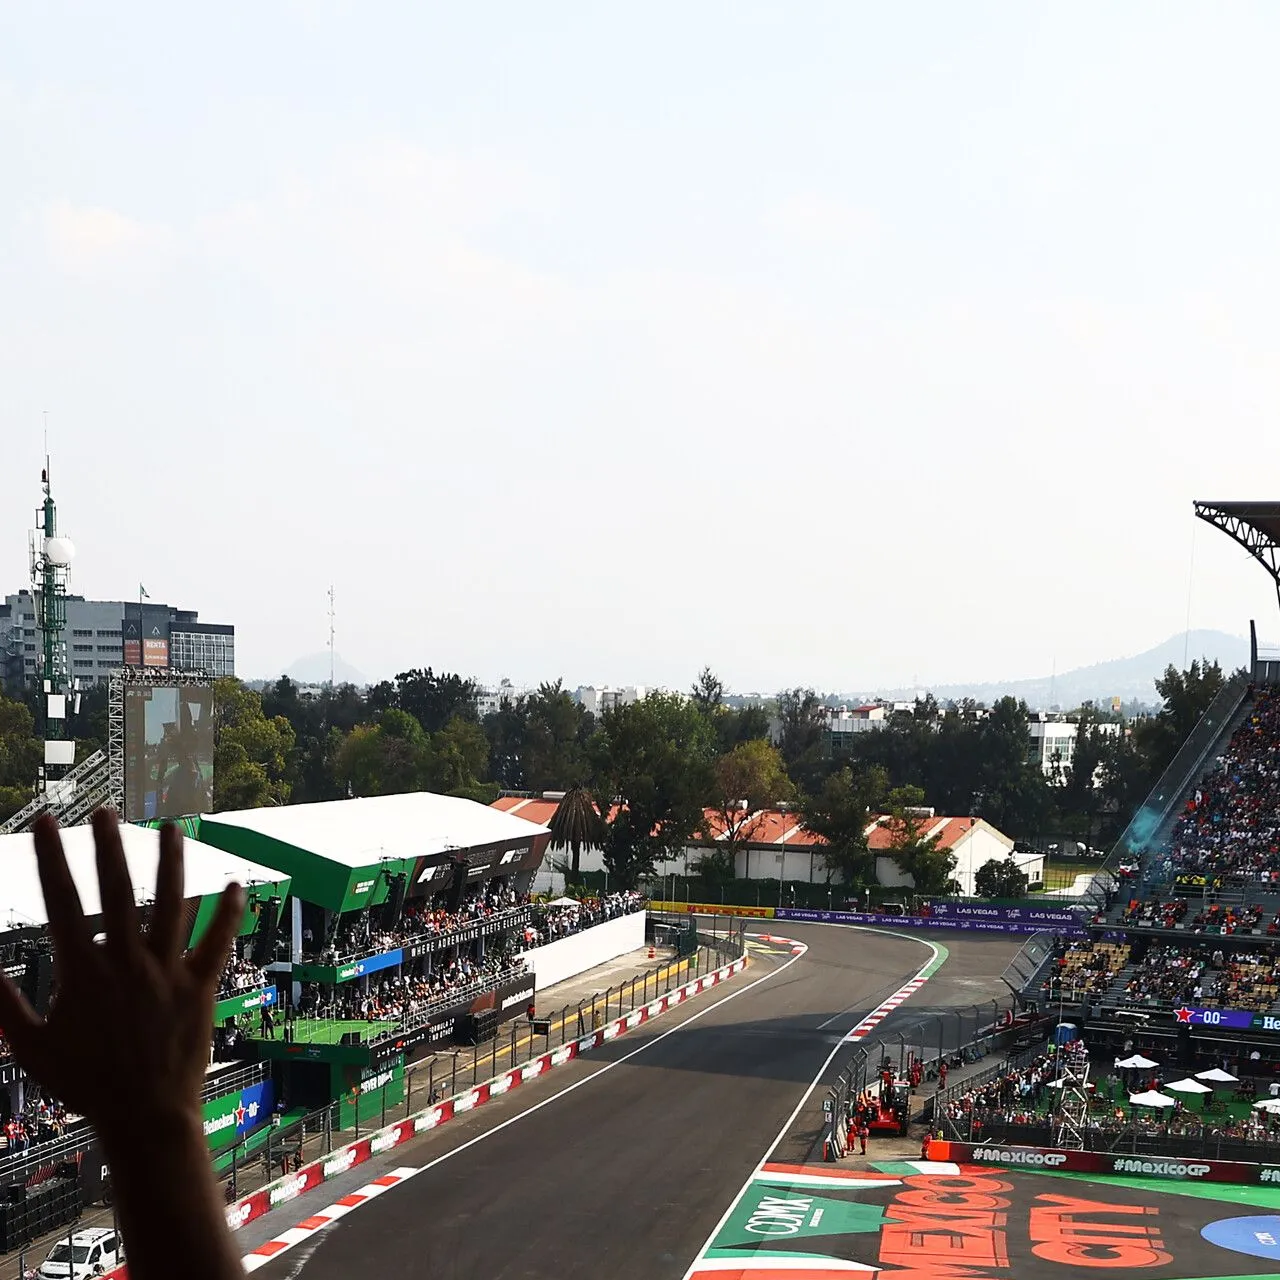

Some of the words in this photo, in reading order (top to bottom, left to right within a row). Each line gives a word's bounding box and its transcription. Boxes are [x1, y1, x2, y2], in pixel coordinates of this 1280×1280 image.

[973, 1148, 1067, 1166] #MexicoGP
[1114, 1159, 1211, 1177] #MexicoGP
[744, 1197, 813, 1235] CDMX
